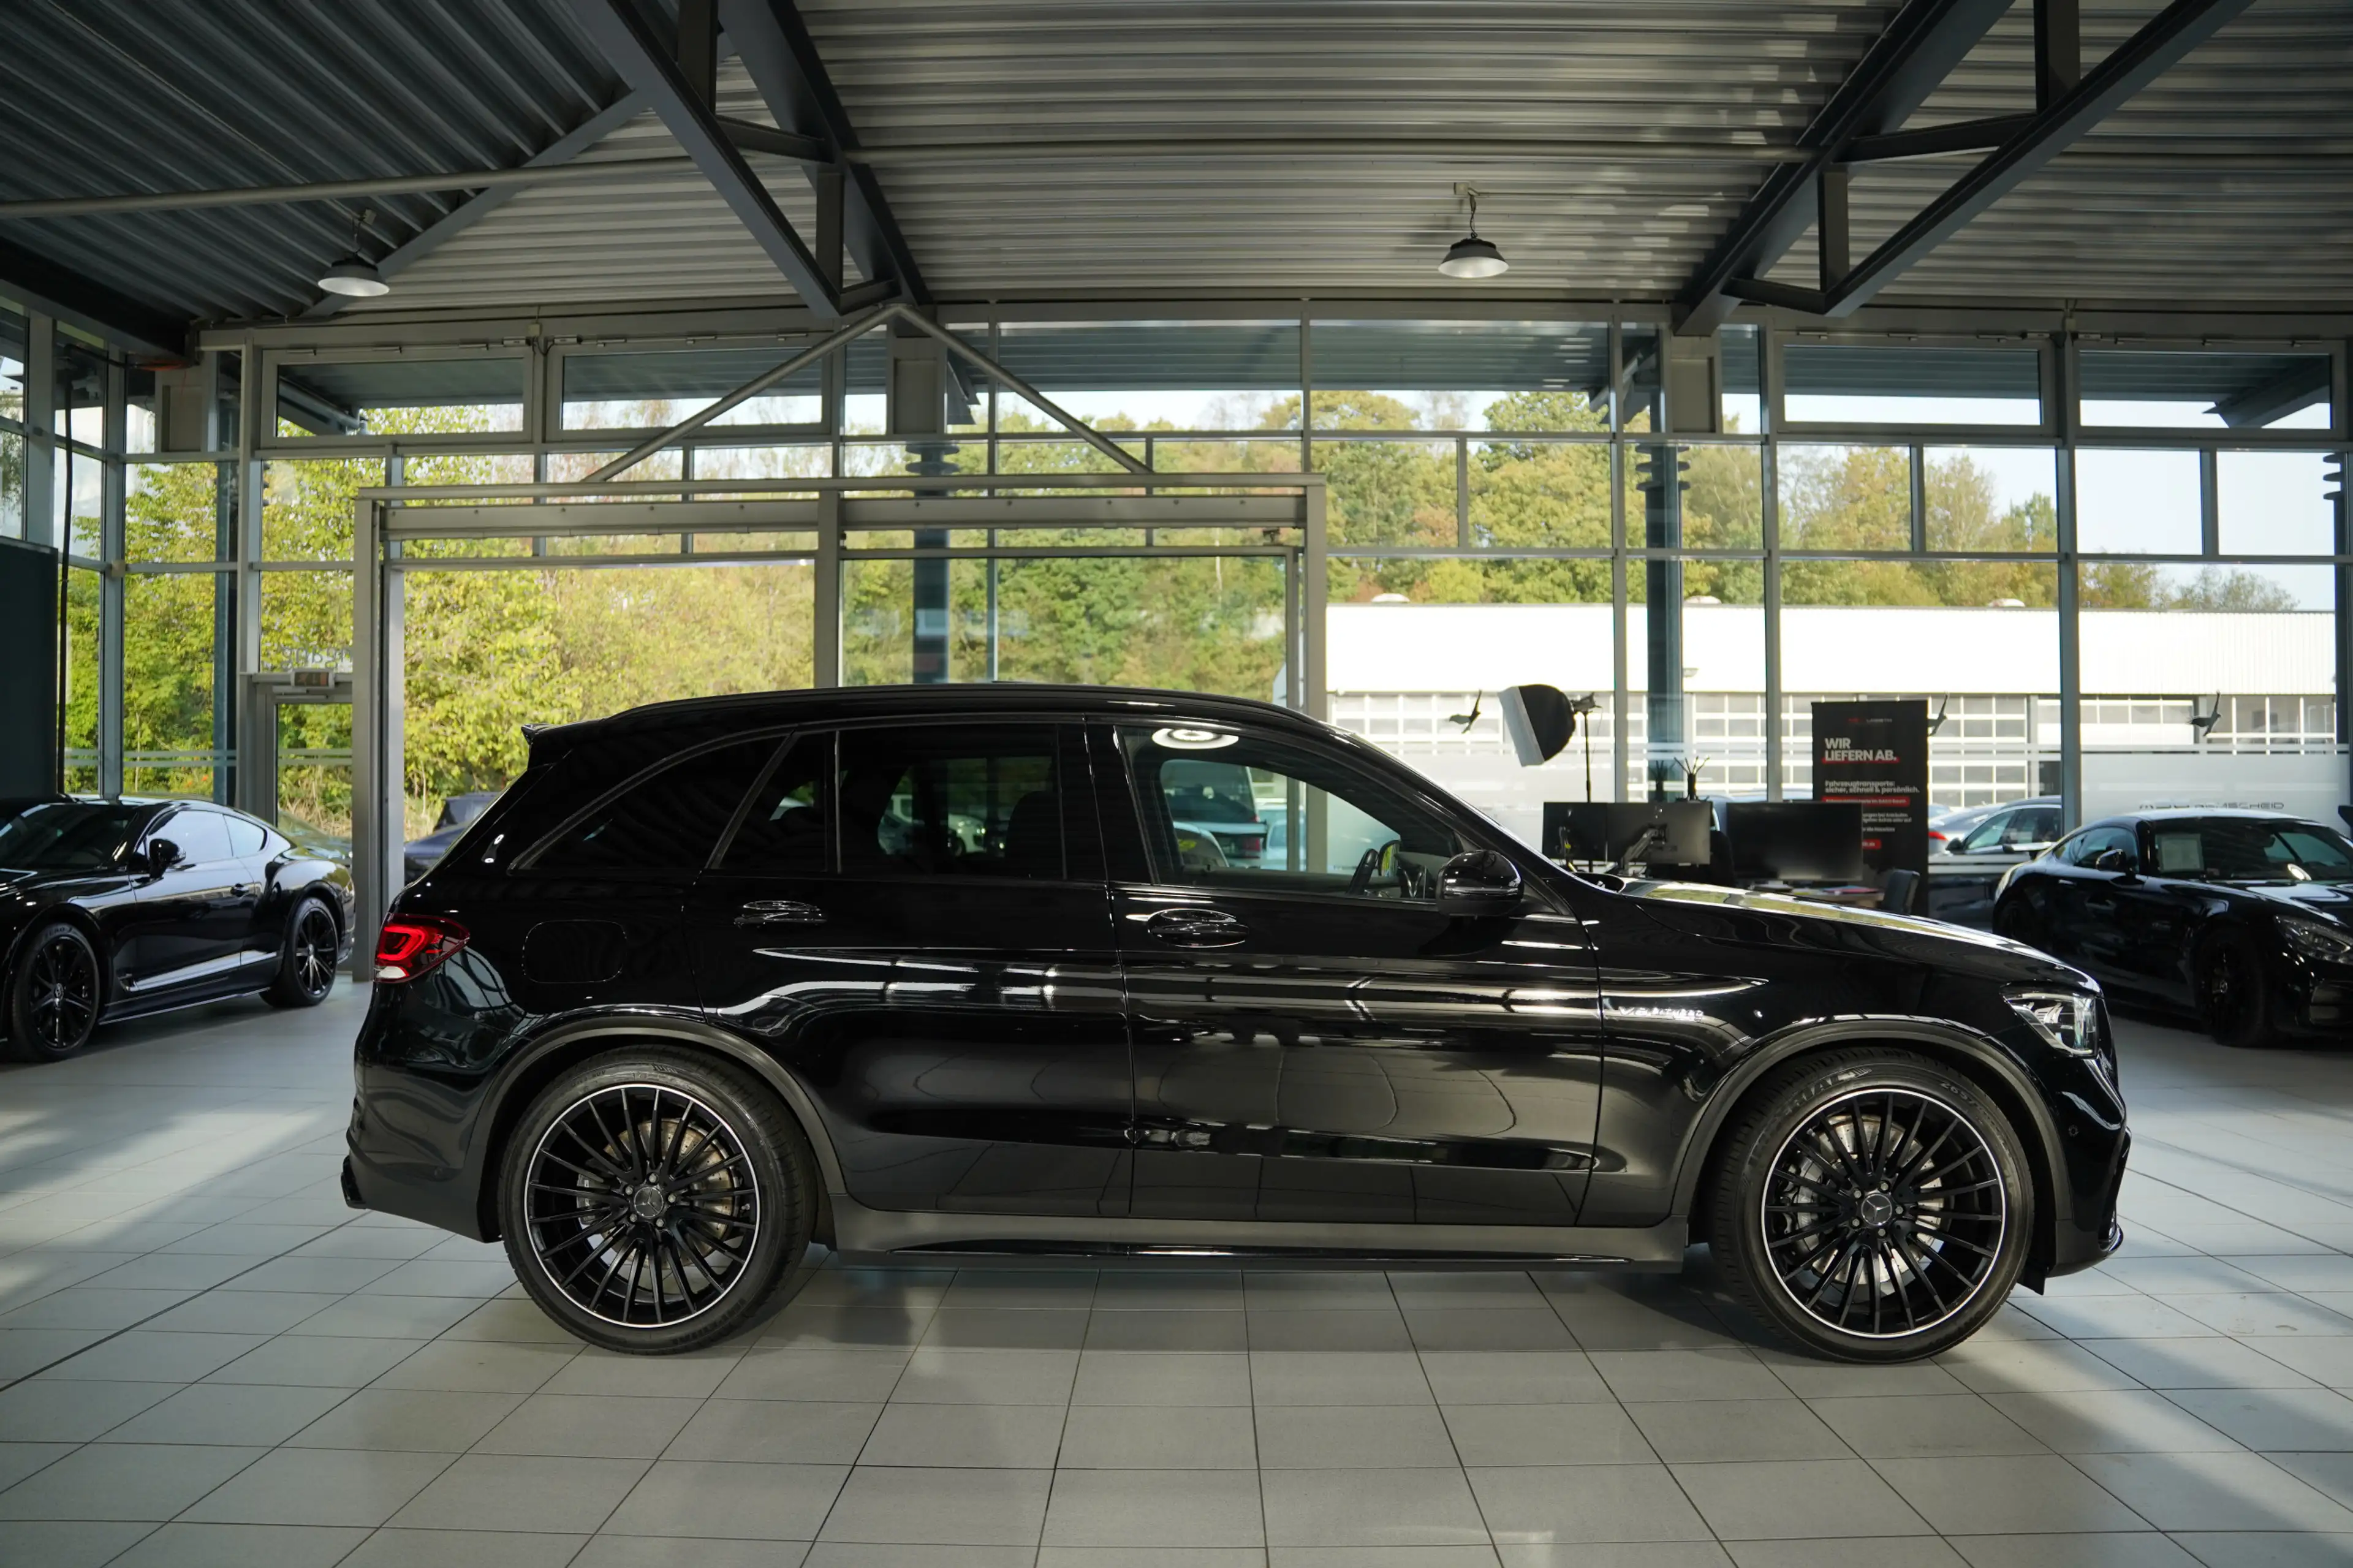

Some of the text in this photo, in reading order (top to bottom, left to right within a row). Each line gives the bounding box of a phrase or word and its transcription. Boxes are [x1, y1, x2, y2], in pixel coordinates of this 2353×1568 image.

[1824, 737, 1851, 749] WIR
[1824, 749, 1898, 762] LIEFERN AB.
